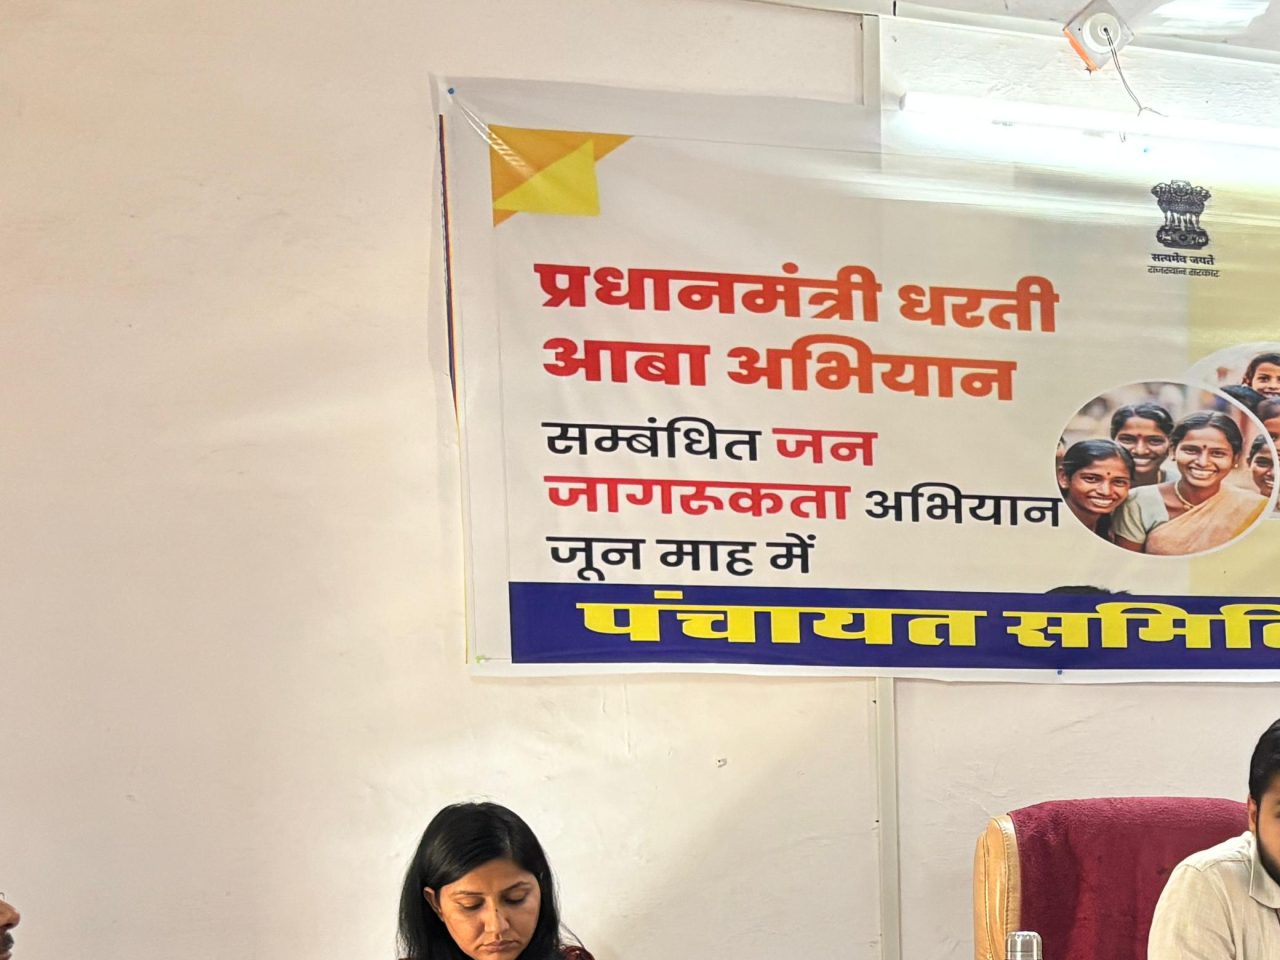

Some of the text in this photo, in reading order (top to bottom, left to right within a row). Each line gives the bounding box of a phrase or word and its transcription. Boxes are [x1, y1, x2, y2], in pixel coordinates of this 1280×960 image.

[1151, 252, 1215, 265] सत्यमेव जयते
[534, 262, 1060, 333] प्रधानमंत्री धरती
[542, 333, 1018, 401] आबा अभियान
[540, 416, 879, 466] सम्बंधित जन
[543, 475, 1063, 527] जागरूकता अभियान
[545, 532, 817, 582] जून माह में
[576, 590, 988, 647] पंचायत
